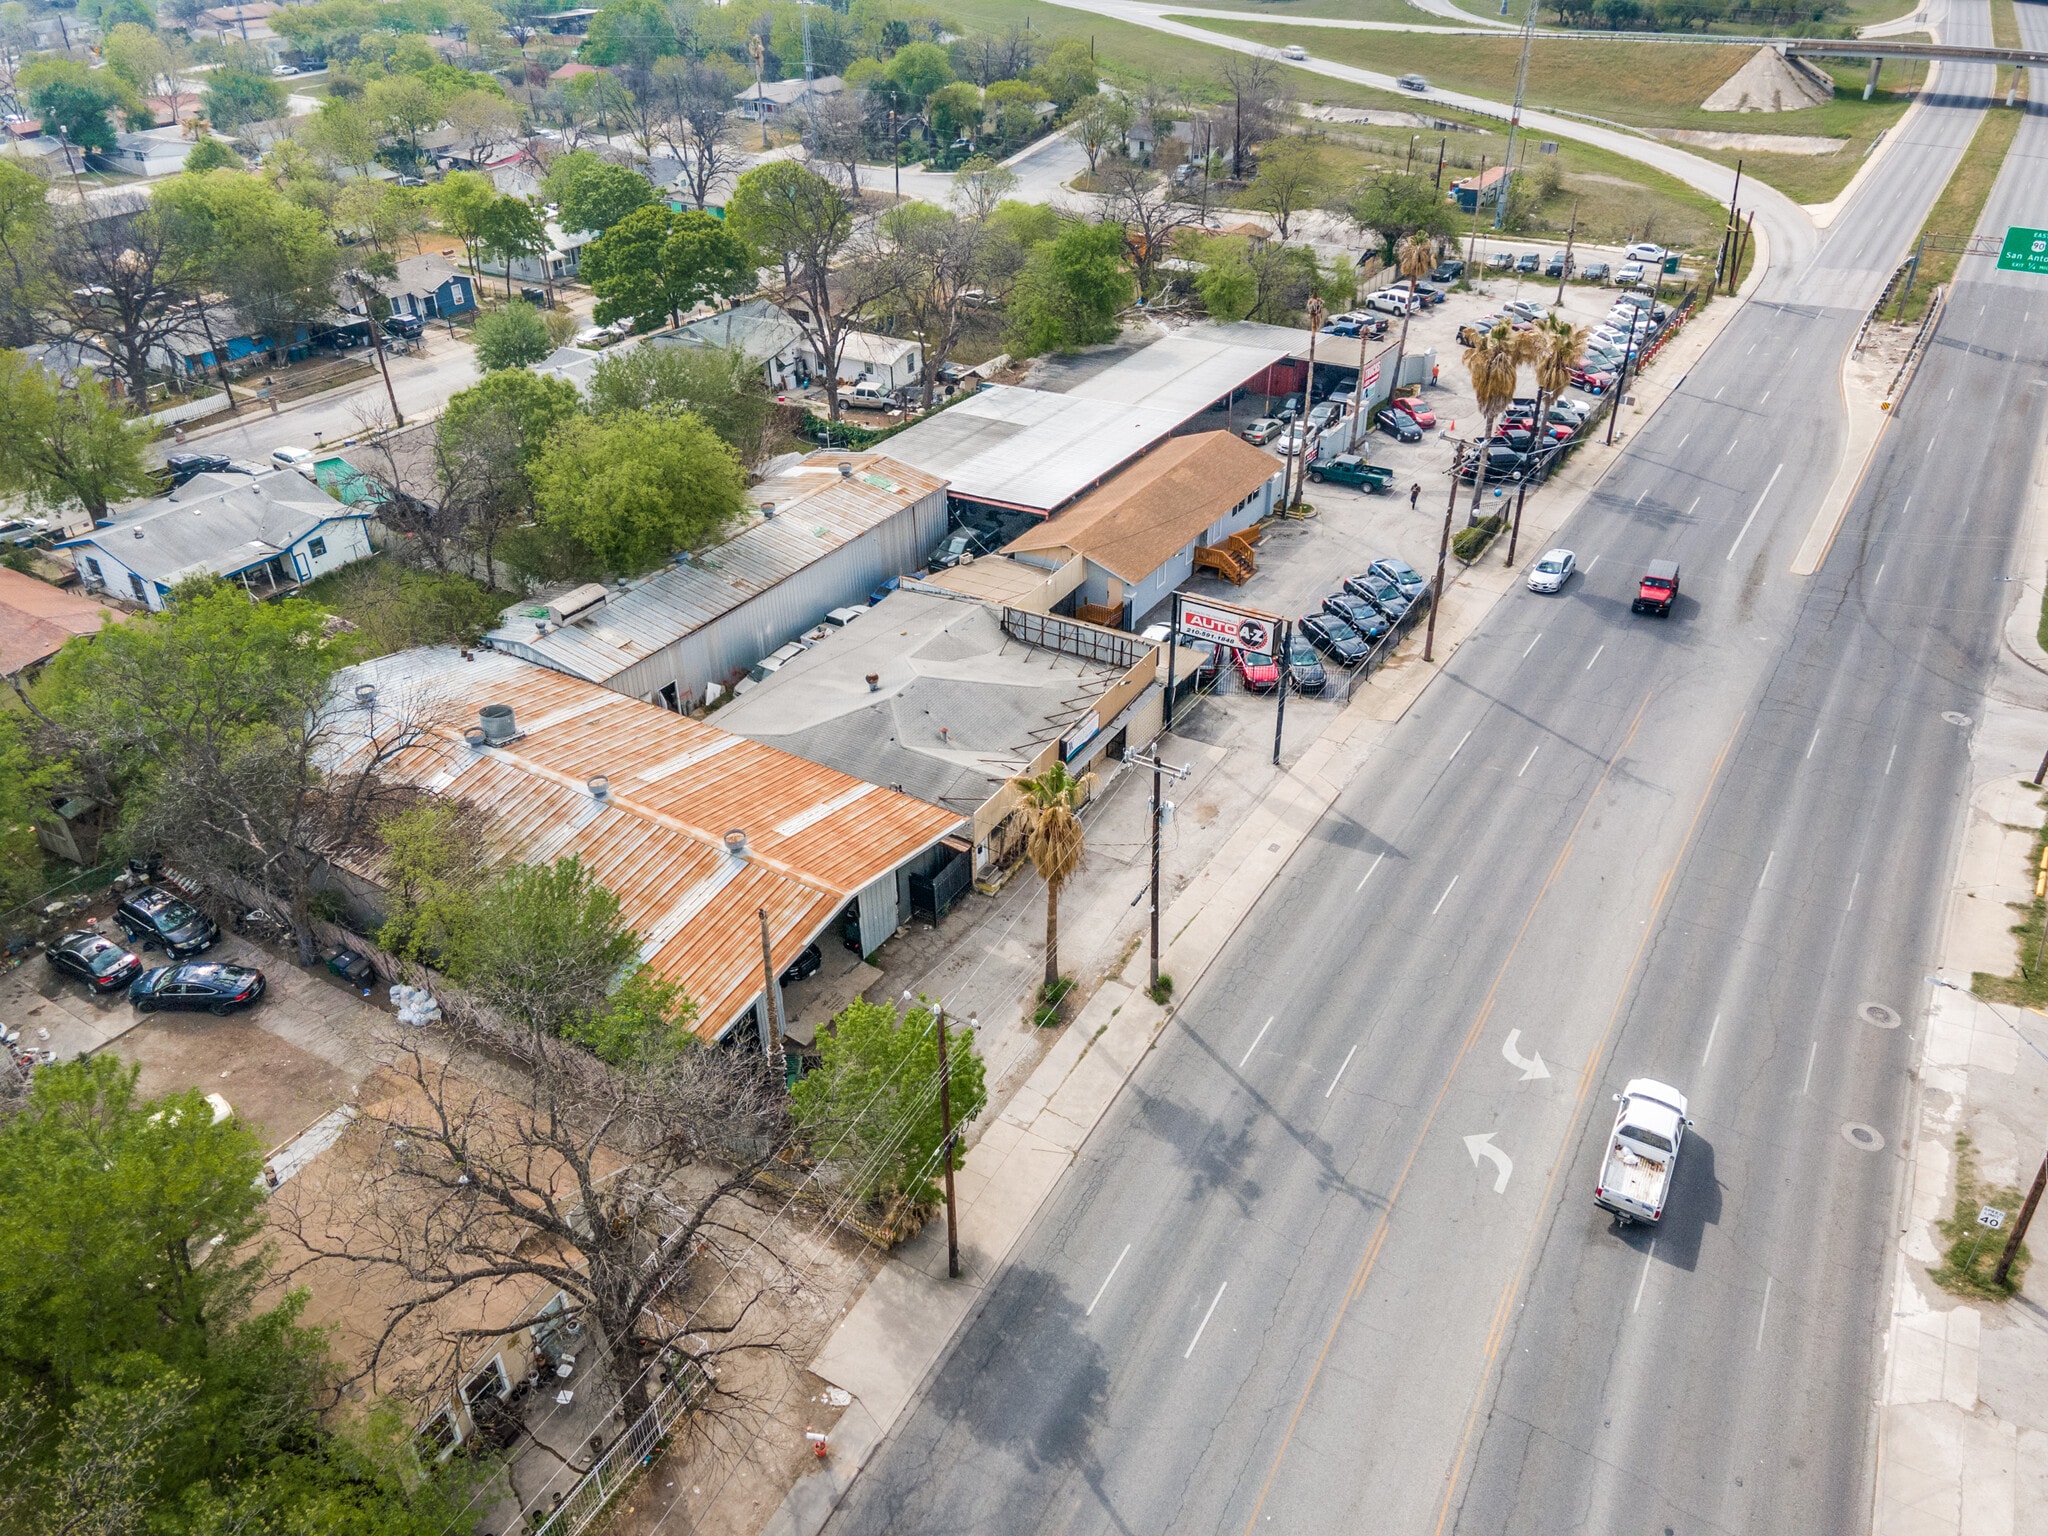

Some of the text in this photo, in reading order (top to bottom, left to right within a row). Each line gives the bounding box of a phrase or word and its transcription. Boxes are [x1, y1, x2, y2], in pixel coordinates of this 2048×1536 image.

[2033, 242, 2045, 250] 90
[1190, 615, 1237, 635] AUTO
[1239, 626, 1264, 643] A-Z
[1980, 1217, 1999, 1227] 40
